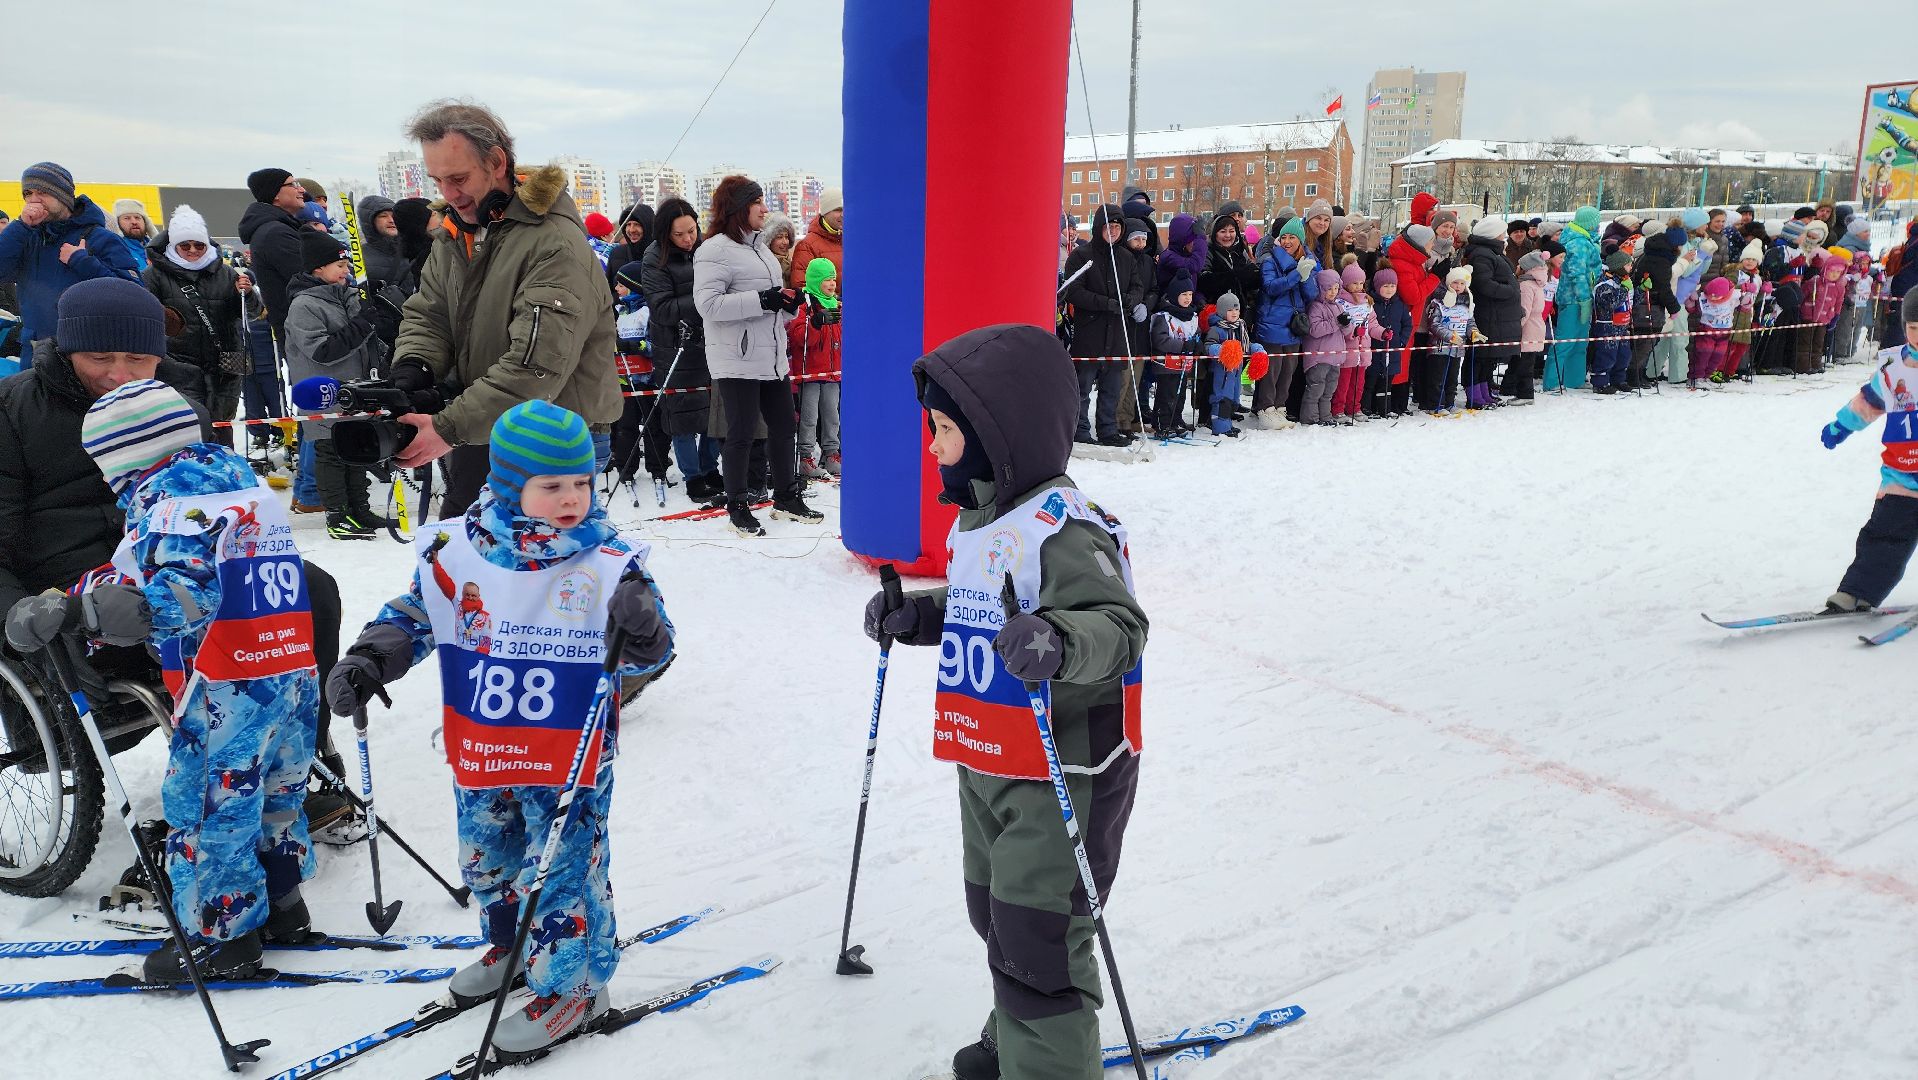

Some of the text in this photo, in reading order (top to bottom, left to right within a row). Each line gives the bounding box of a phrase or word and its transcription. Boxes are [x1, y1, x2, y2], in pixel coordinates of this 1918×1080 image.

[244, 561, 300, 612] 189
[258, 631, 275, 643] на
[498, 620, 563, 637] Детская
[468, 659, 555, 721] 188
[944, 711, 979, 730] призы
[474, 741, 529, 757] призы
[956, 729, 1002, 756] Шилова
[484, 758, 553, 773] Шилова
[647, 975, 727, 1010] XC JUNIOR
